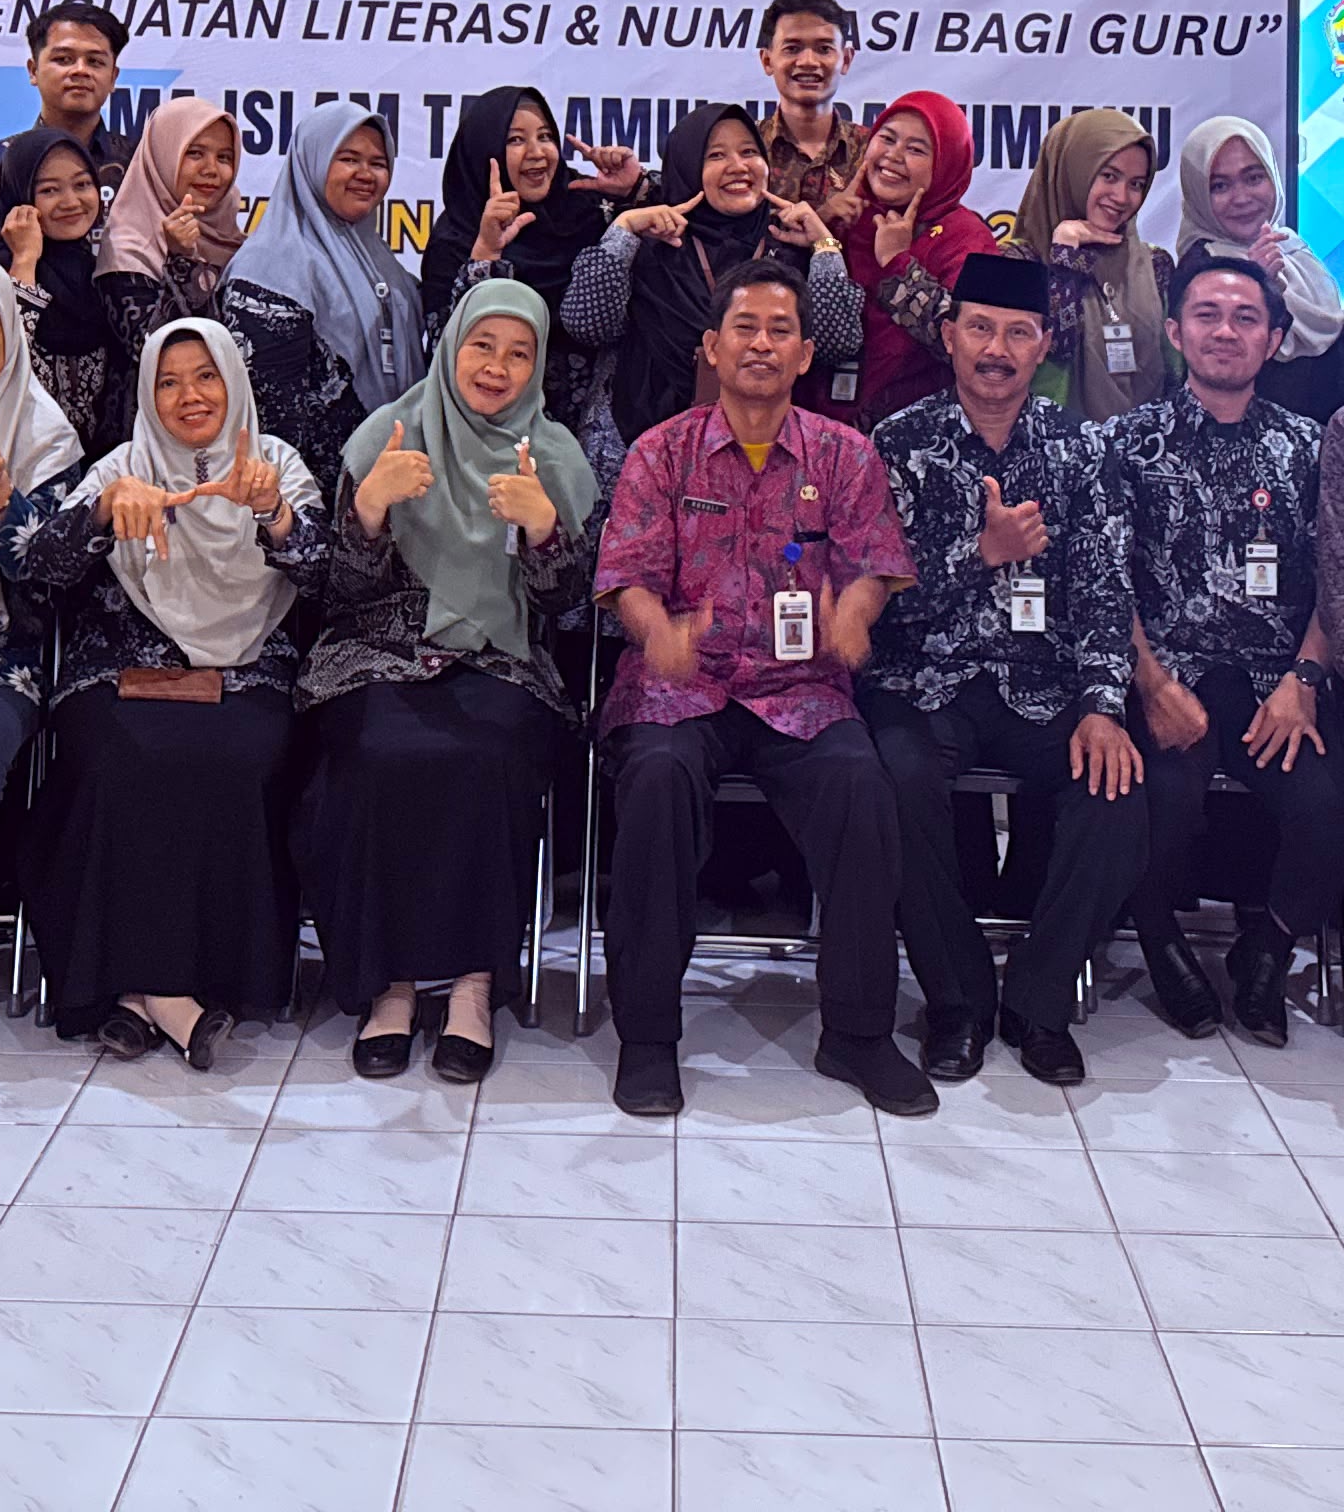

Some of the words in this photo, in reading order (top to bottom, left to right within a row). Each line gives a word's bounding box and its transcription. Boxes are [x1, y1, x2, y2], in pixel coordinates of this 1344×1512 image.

[302, 0, 551, 45] LITERASI
[565, 4, 599, 46] &
[618, 6, 919, 53] NUMASI
[934, 12, 1072, 54] BAGI
[1089, 13, 1282, 56] GURU”
